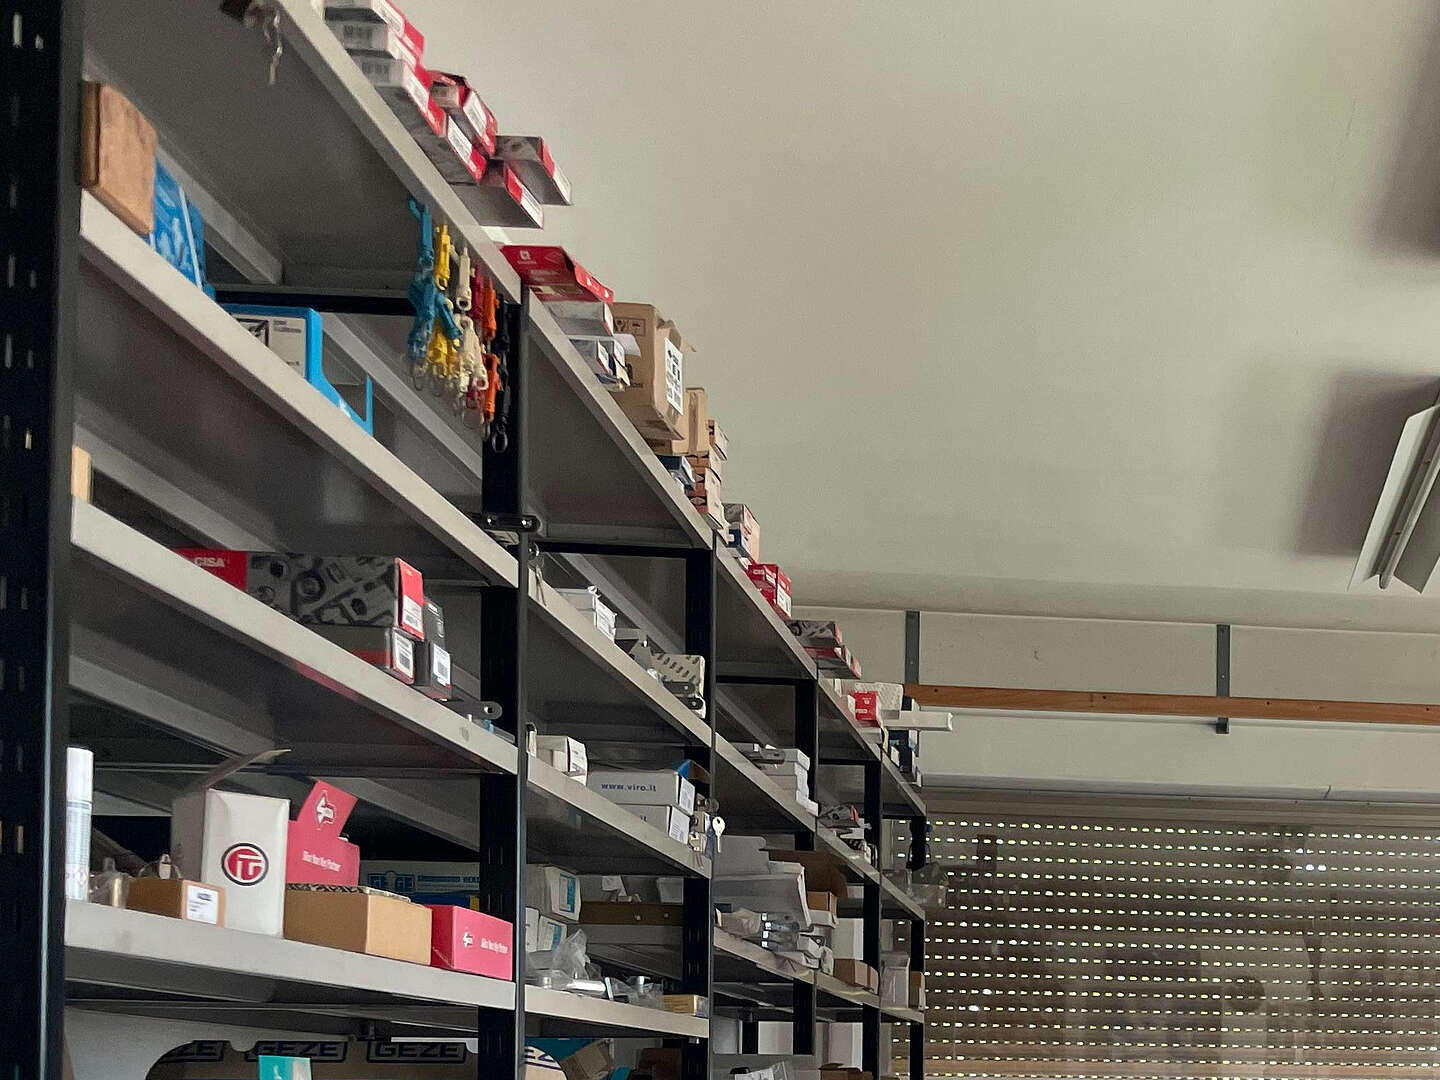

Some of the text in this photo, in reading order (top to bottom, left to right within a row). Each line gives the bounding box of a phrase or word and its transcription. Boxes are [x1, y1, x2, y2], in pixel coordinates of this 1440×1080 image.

[194, 556, 224, 567] CISA
[601, 783, 657, 792] www.viro.it
[252, 1043, 340, 1058] GEZE
[373, 1043, 458, 1058] GEZE
